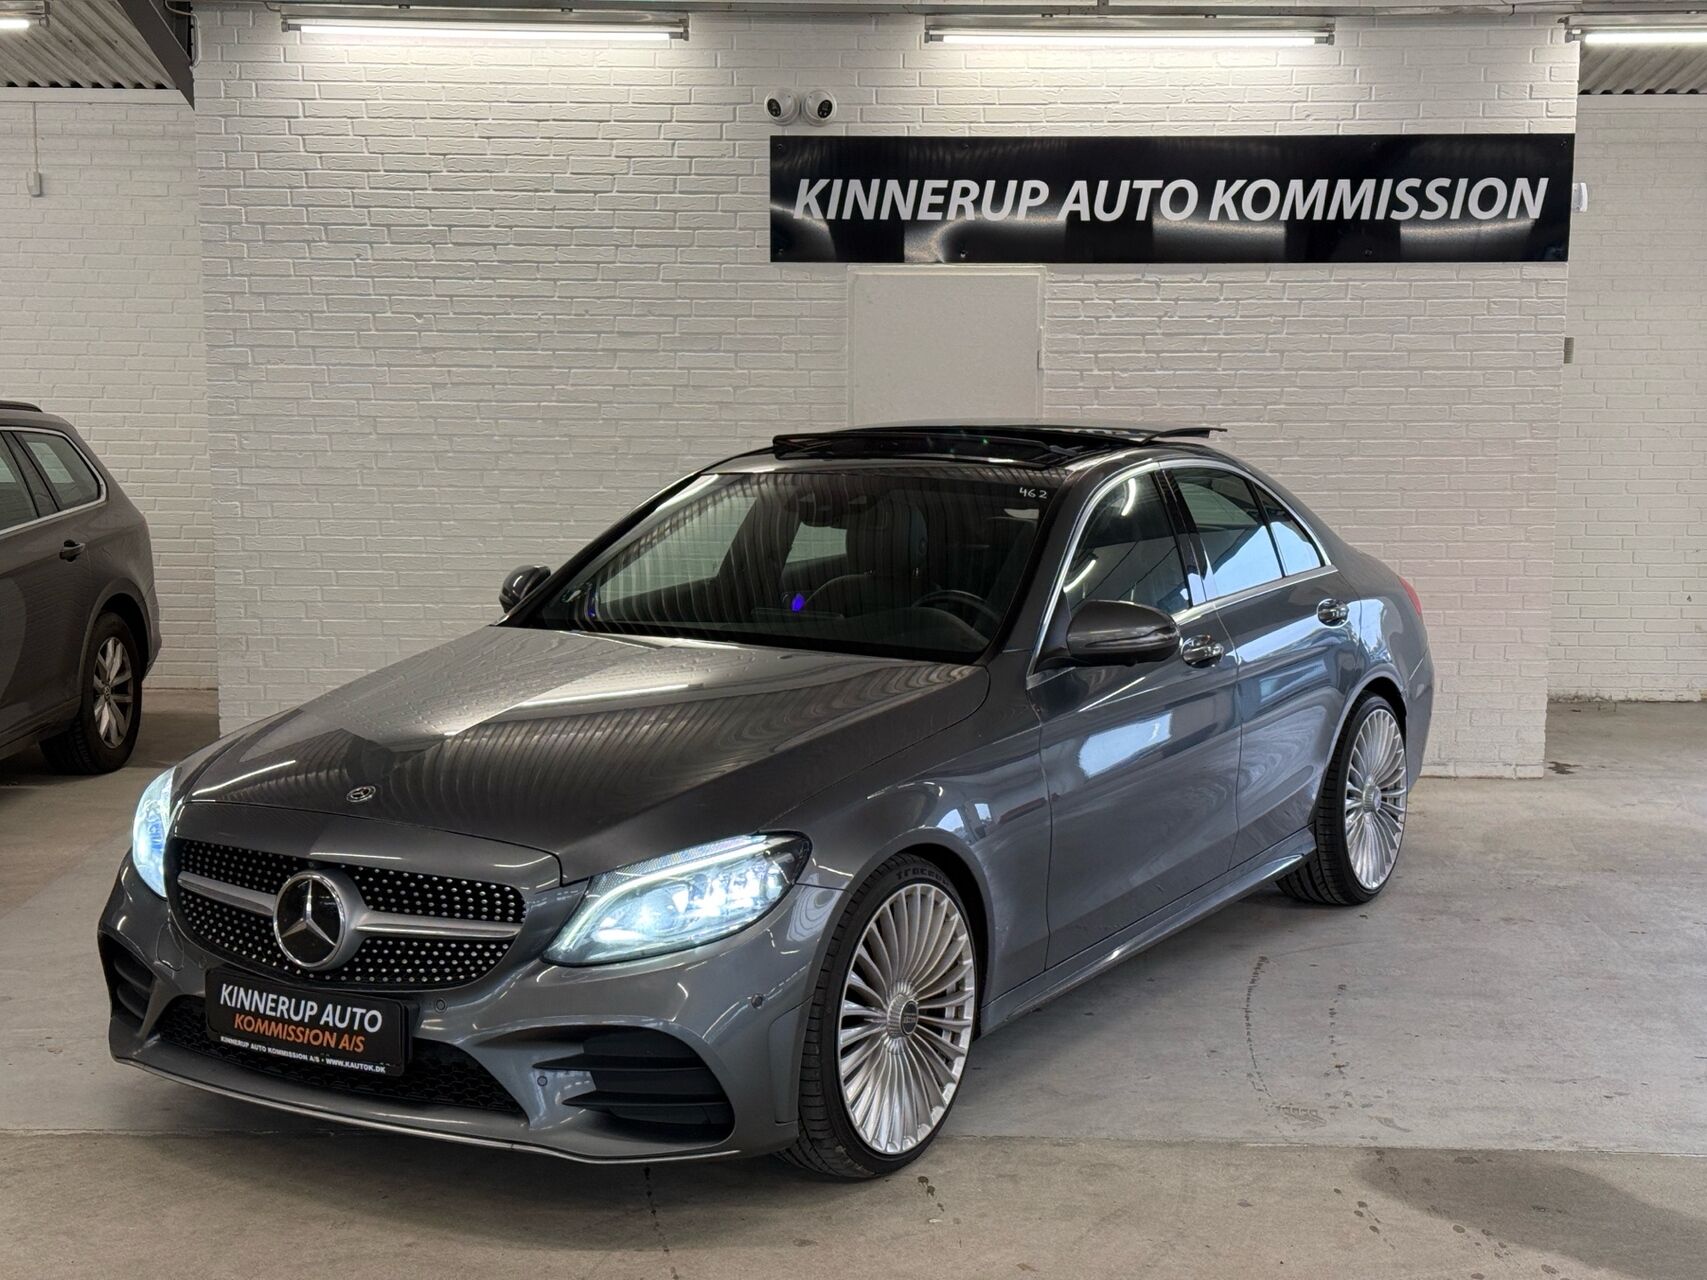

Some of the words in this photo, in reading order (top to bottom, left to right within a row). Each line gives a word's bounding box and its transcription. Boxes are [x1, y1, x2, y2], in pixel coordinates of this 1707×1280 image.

[792, 178, 1050, 221] KINNERUP
[1056, 178, 1198, 221] AUTO
[1209, 177, 1549, 221] KOMMISSION
[1019, 487, 1047, 499] 462
[220, 983, 317, 1023] KINNERUP
[320, 1003, 383, 1033] AUTO
[234, 1013, 336, 1049] KOMMISSION
[338, 1033, 366, 1053] A/S
[220, 1036, 249, 1049] KINNERUP
[250, 1043, 267, 1053] AUTO
[268, 1048, 308, 1060] KOMMISSION
[325, 1058, 386, 1073] WWW.KAUTOK.DK
